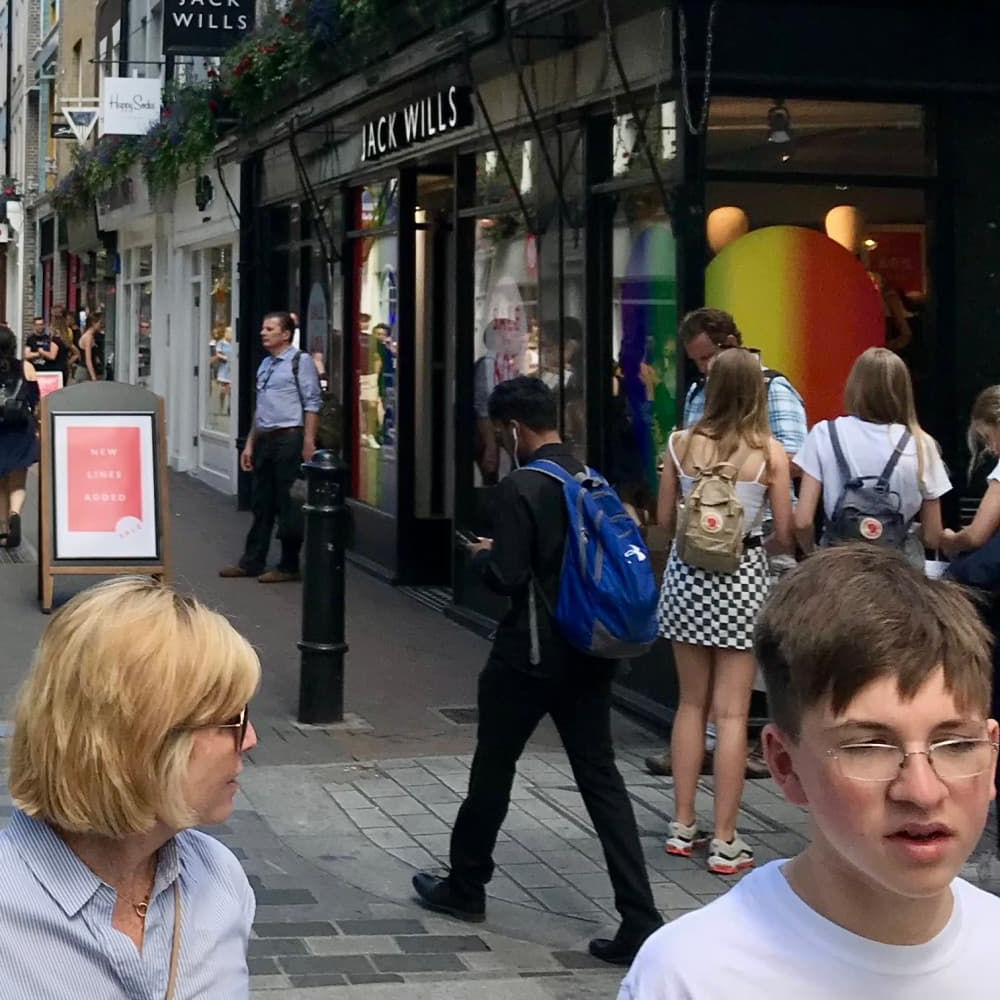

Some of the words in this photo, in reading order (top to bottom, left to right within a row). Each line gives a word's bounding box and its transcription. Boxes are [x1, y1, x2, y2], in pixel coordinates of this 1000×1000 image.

[172, 12, 248, 30] WILLS
[361, 111, 398, 162] JACK
[403, 85, 458, 143] WILLS
[90, 448, 118, 457] NEW
[87, 471, 122, 480] LINES
[83, 494, 127, 503] ADDED
